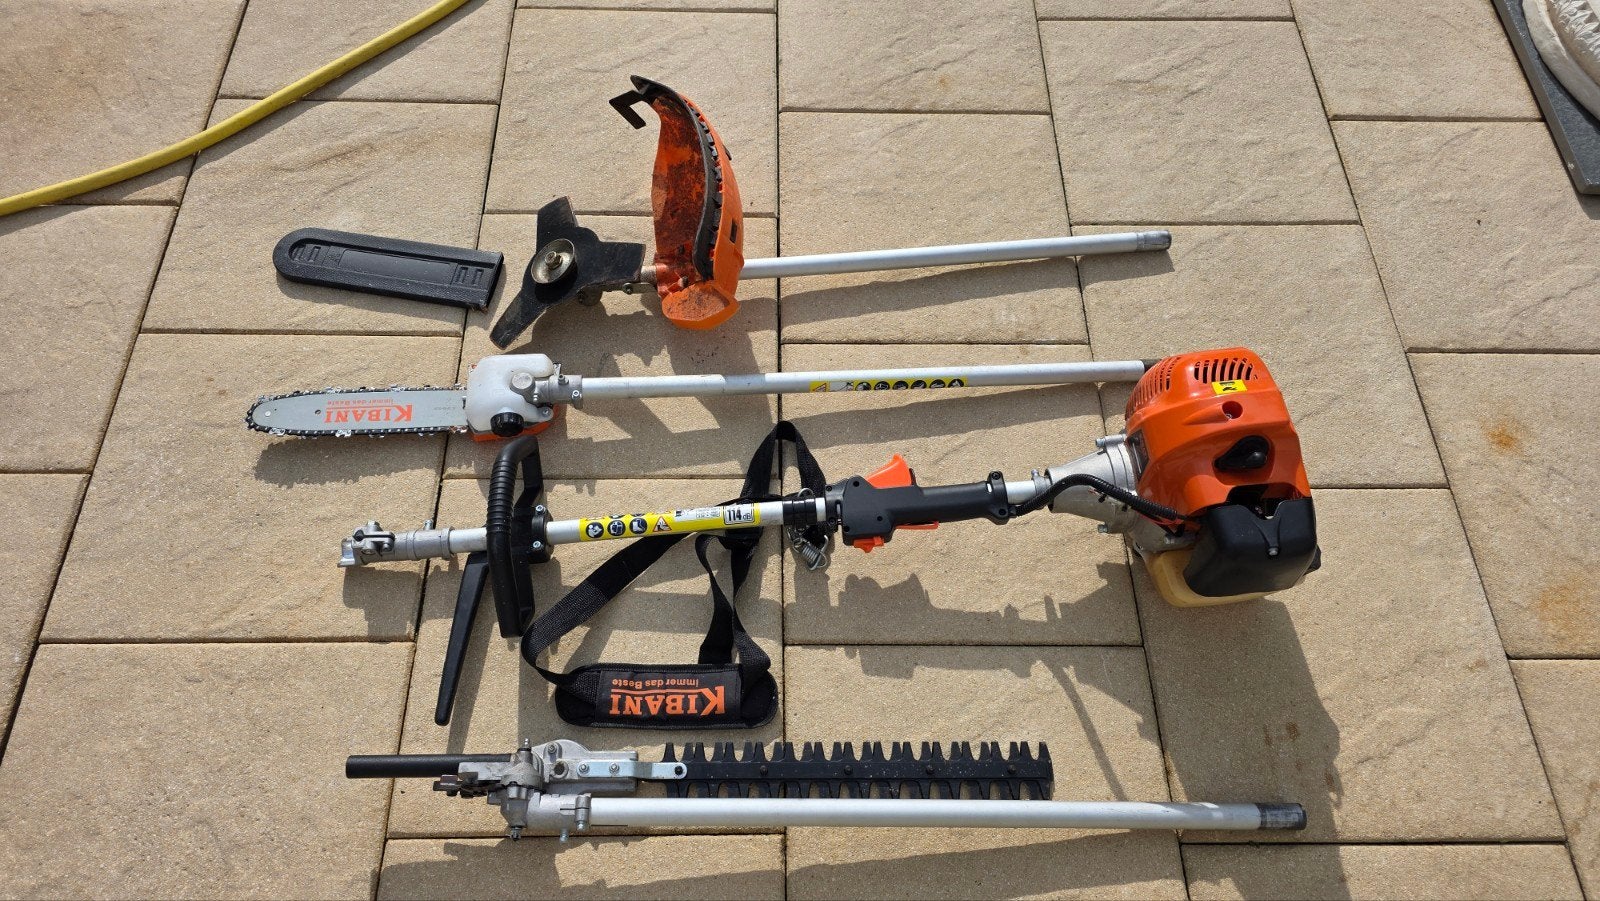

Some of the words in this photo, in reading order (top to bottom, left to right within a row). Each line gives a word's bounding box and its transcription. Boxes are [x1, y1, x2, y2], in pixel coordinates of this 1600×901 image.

[324, 404, 412, 423] KIBANI
[727, 508, 742, 521] 114
[743, 512, 752, 520] dB
[612, 678, 642, 690] Beste
[645, 678, 664, 688] das
[609, 686, 725, 715] KIBANI
